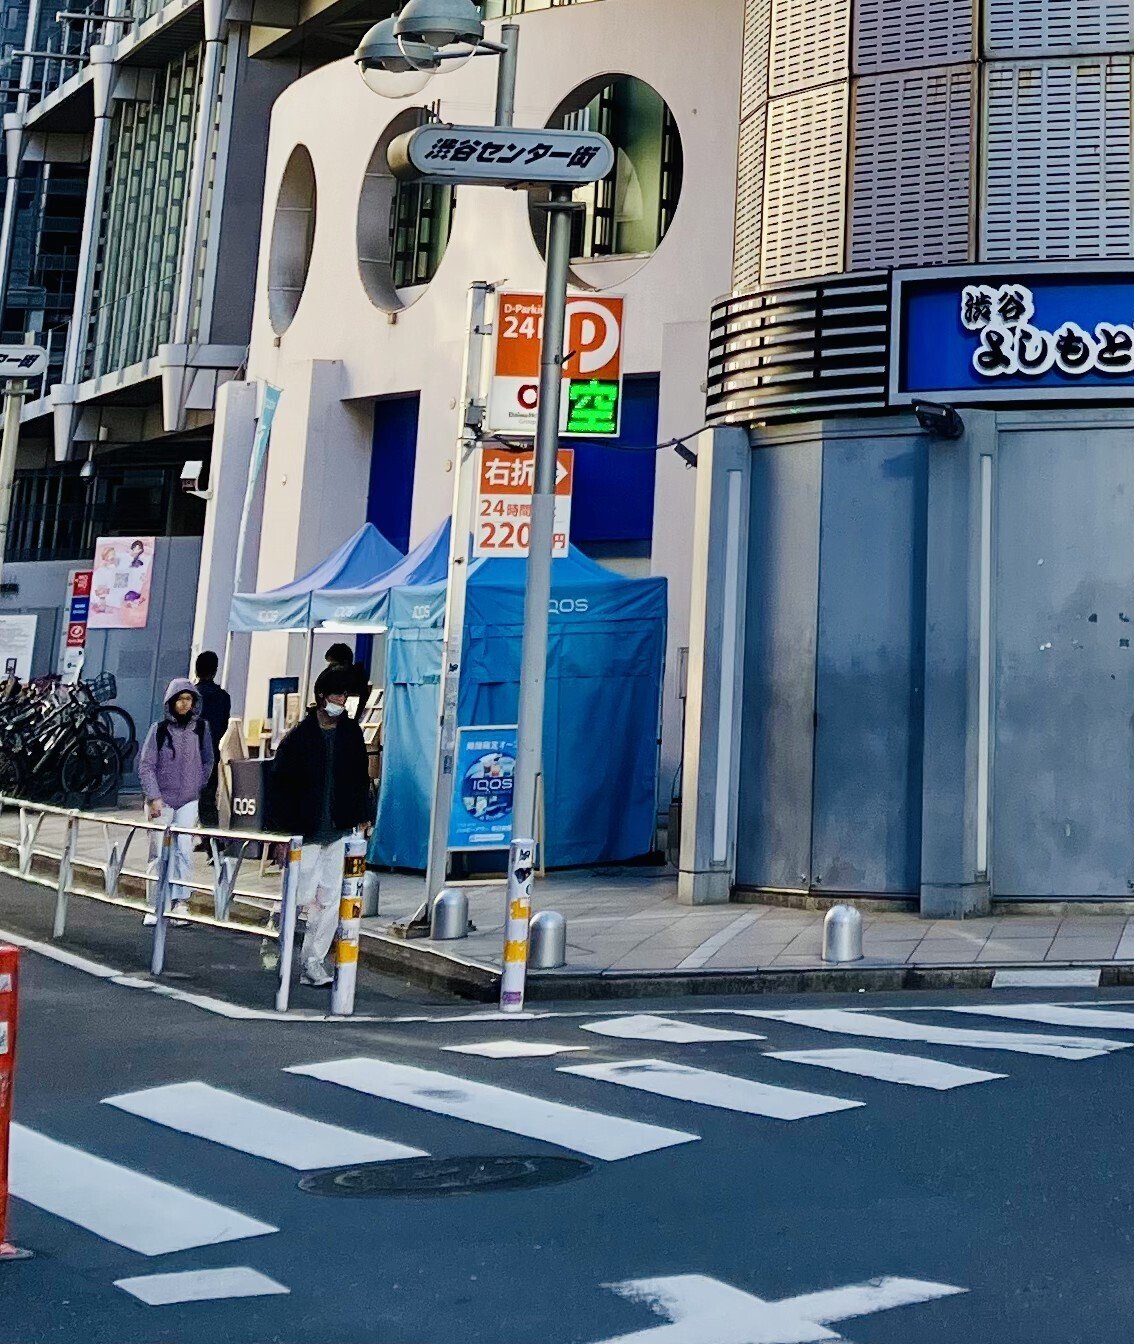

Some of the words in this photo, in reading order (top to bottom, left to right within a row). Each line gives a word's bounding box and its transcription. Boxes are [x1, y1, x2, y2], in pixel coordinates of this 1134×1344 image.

[424, 137, 601, 169] 渋谷センター街
[504, 303, 544, 315] D-Parki
[963, 286, 1032, 328] 渋谷
[568, 378, 618, 433] 空
[484, 457, 535, 487] 右折
[548, 598, 589, 614] QOS
[473, 778, 513, 792] IQOS
